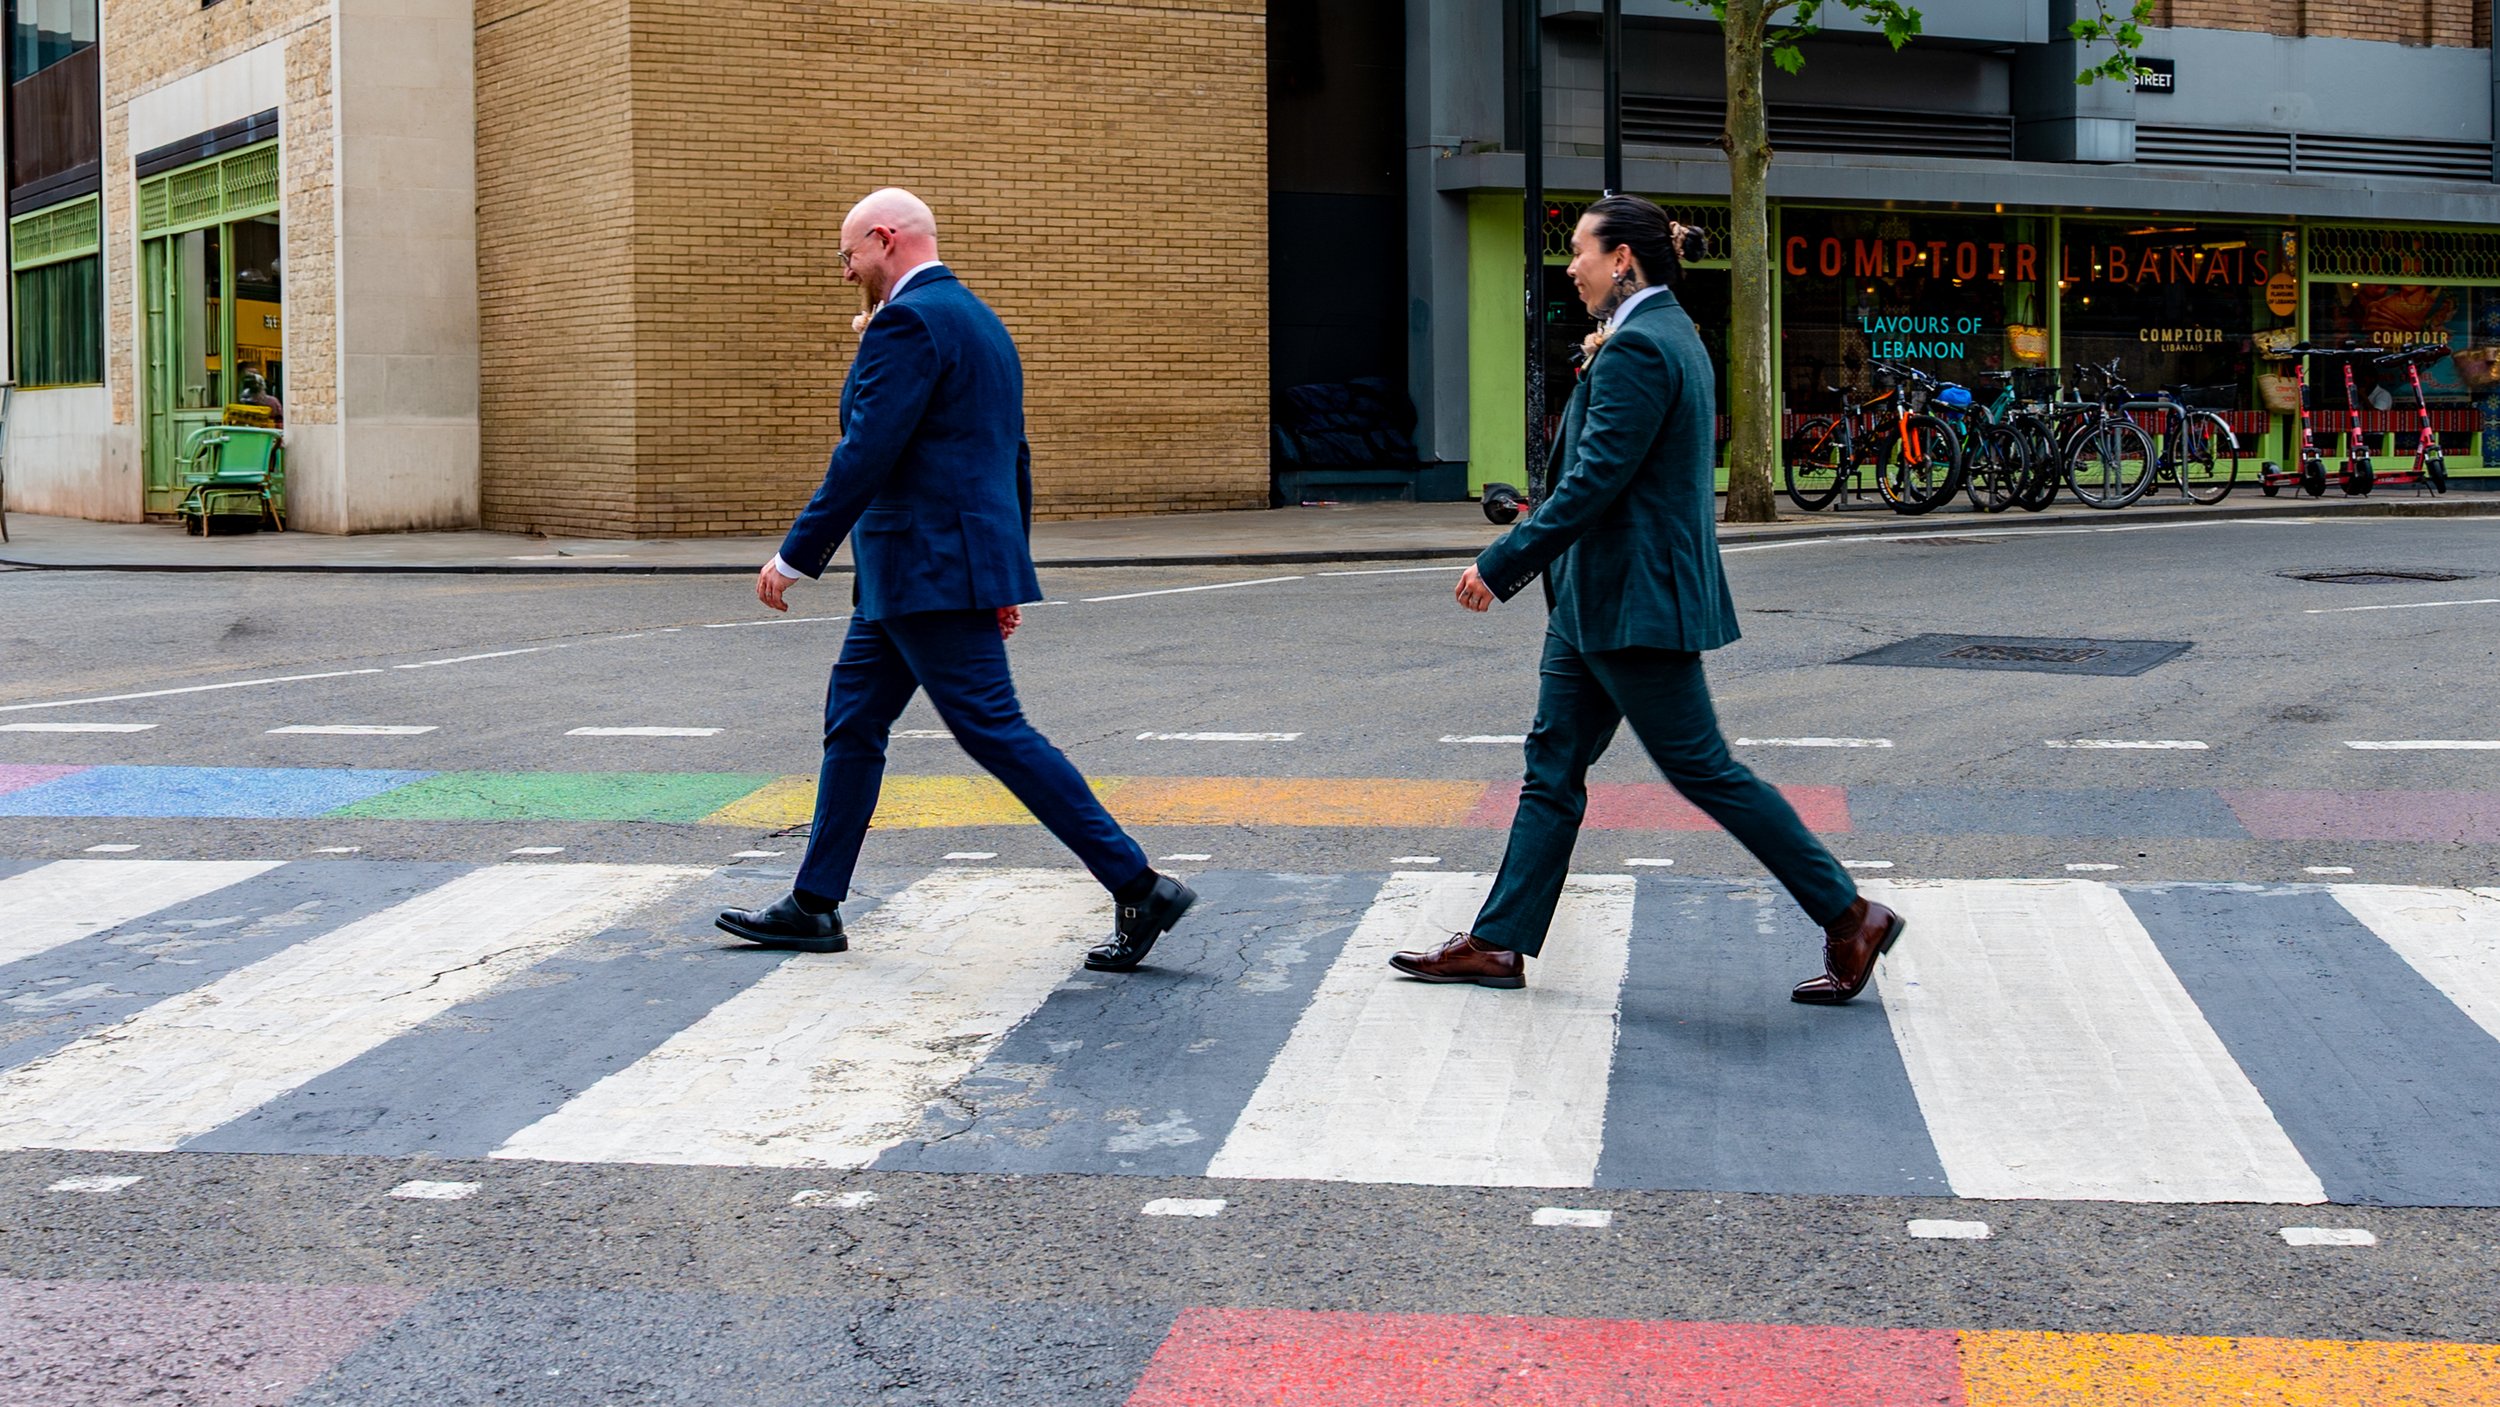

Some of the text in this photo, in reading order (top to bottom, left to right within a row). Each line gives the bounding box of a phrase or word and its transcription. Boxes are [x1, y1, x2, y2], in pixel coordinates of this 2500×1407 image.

[1785, 235, 2269, 286] COMPTOIR LIBANAIS
[1858, 316, 1982, 335] LAVOURS OF
[2139, 328, 2223, 343] COMPTOIR
[2372, 331, 2448, 344] COMPTOIR
[1872, 341, 1965, 359] LEBANON
[2161, 343, 2203, 353] LIBANAIS
